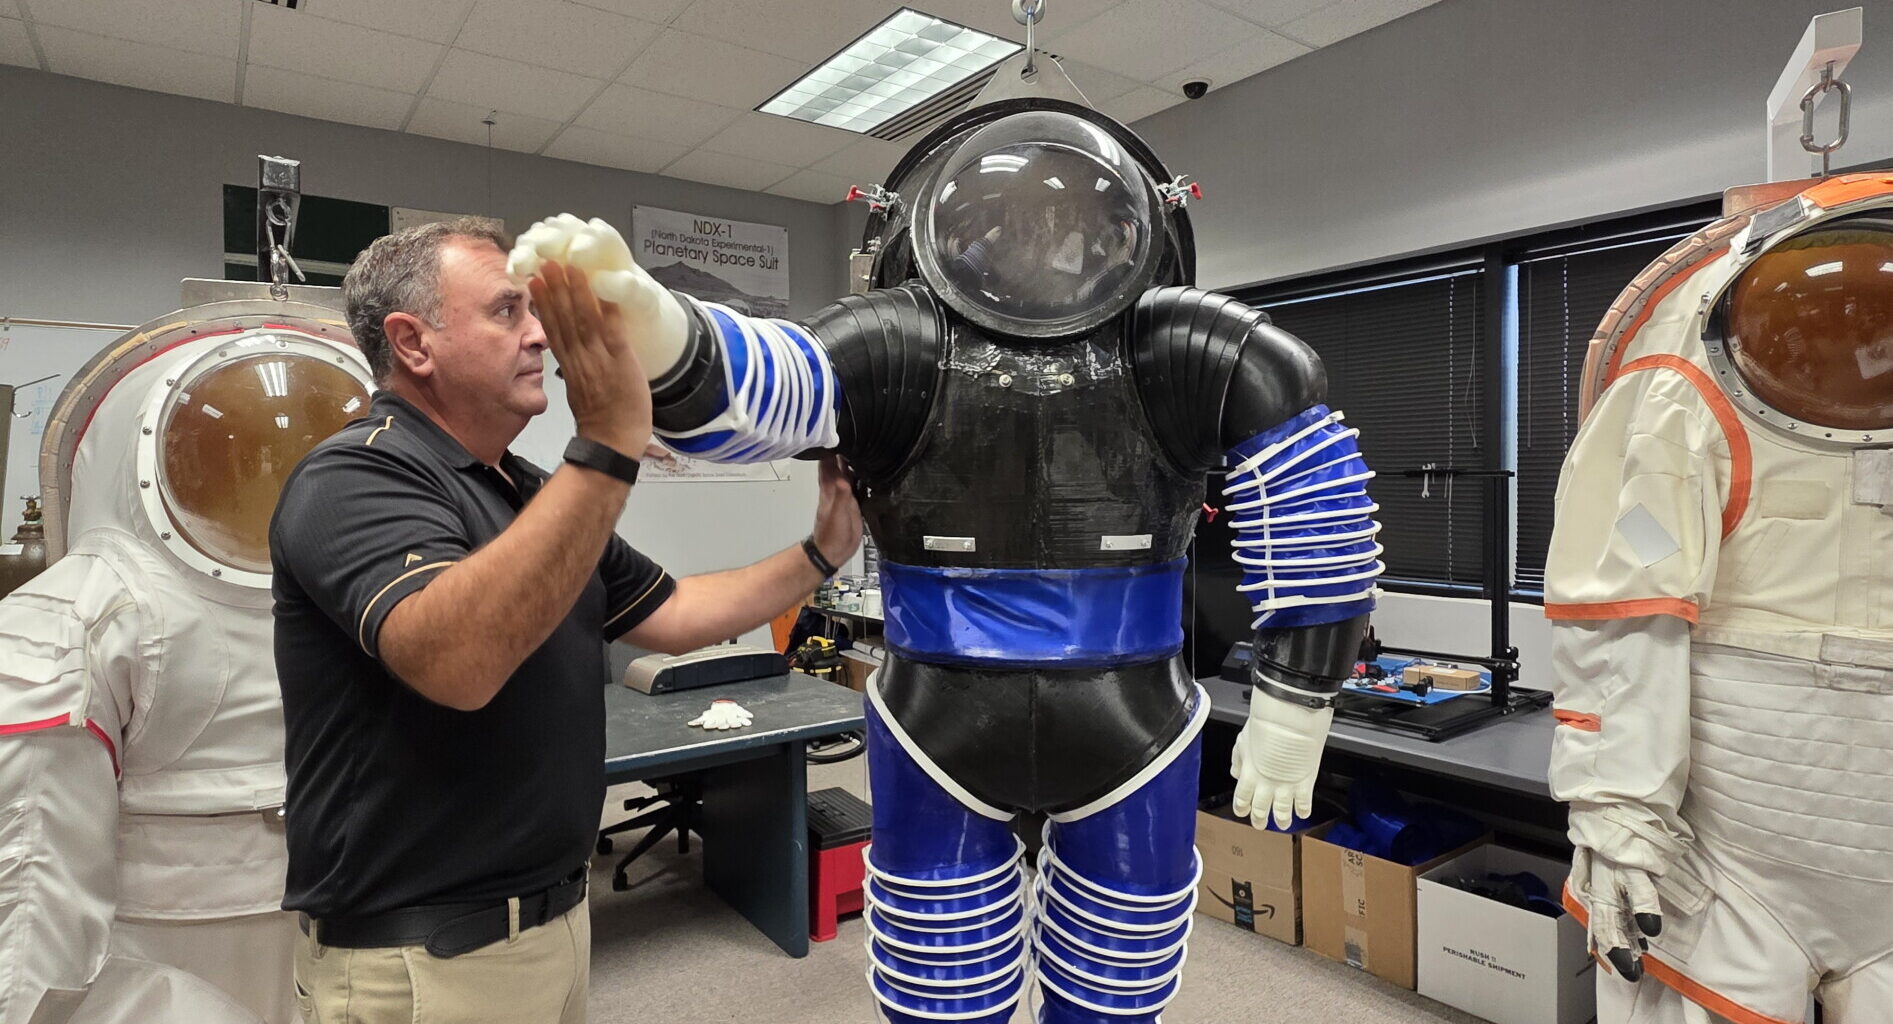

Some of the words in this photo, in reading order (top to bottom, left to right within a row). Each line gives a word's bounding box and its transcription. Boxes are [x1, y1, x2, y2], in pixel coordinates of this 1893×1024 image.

[693, 219, 732, 238] NDX-1
[679, 233, 709, 246] Dakota
[643, 239, 708, 264] Planetary
[712, 249, 756, 267] Space
[759, 254, 779, 270] Suit
[1442, 946, 1487, 966] PERISHABLE
[1487, 962, 1526, 979] SHIPMENT
[1469, 948, 1490, 960] RUSH
